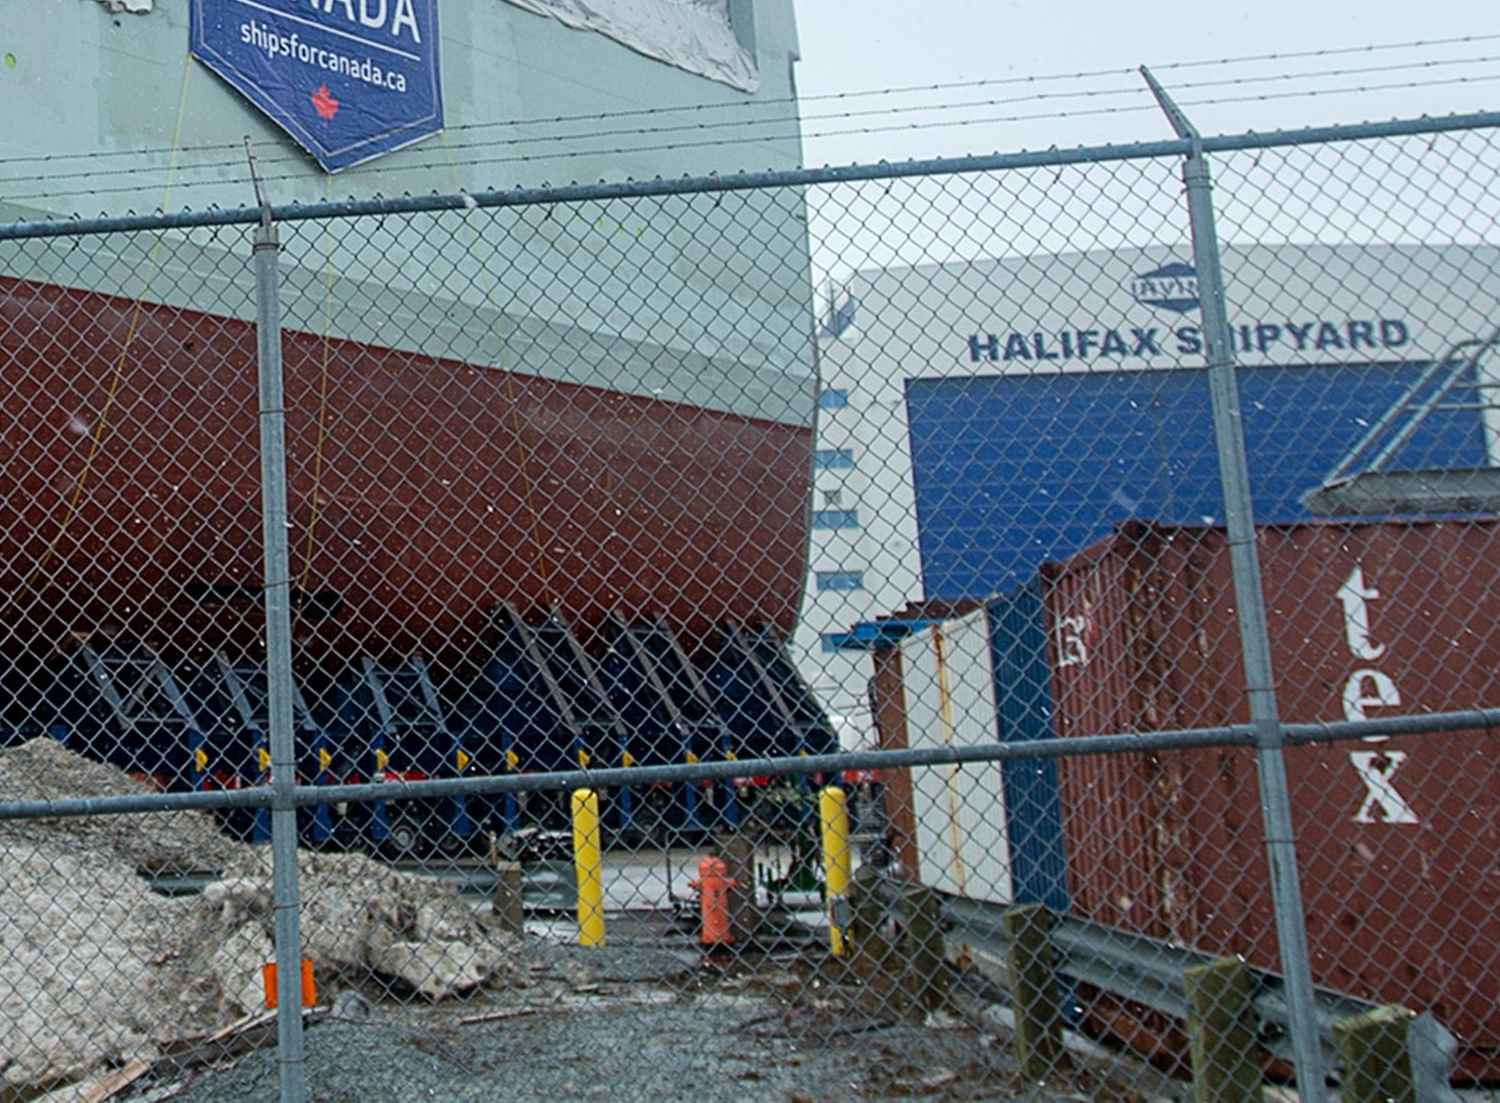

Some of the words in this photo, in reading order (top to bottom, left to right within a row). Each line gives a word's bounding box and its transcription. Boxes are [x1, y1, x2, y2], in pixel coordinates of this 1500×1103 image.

[241, 20, 407, 93] shipsforcanada.ca
[968, 328, 1161, 363] HALIFAX
[1177, 319, 1410, 355] SIPYARD
